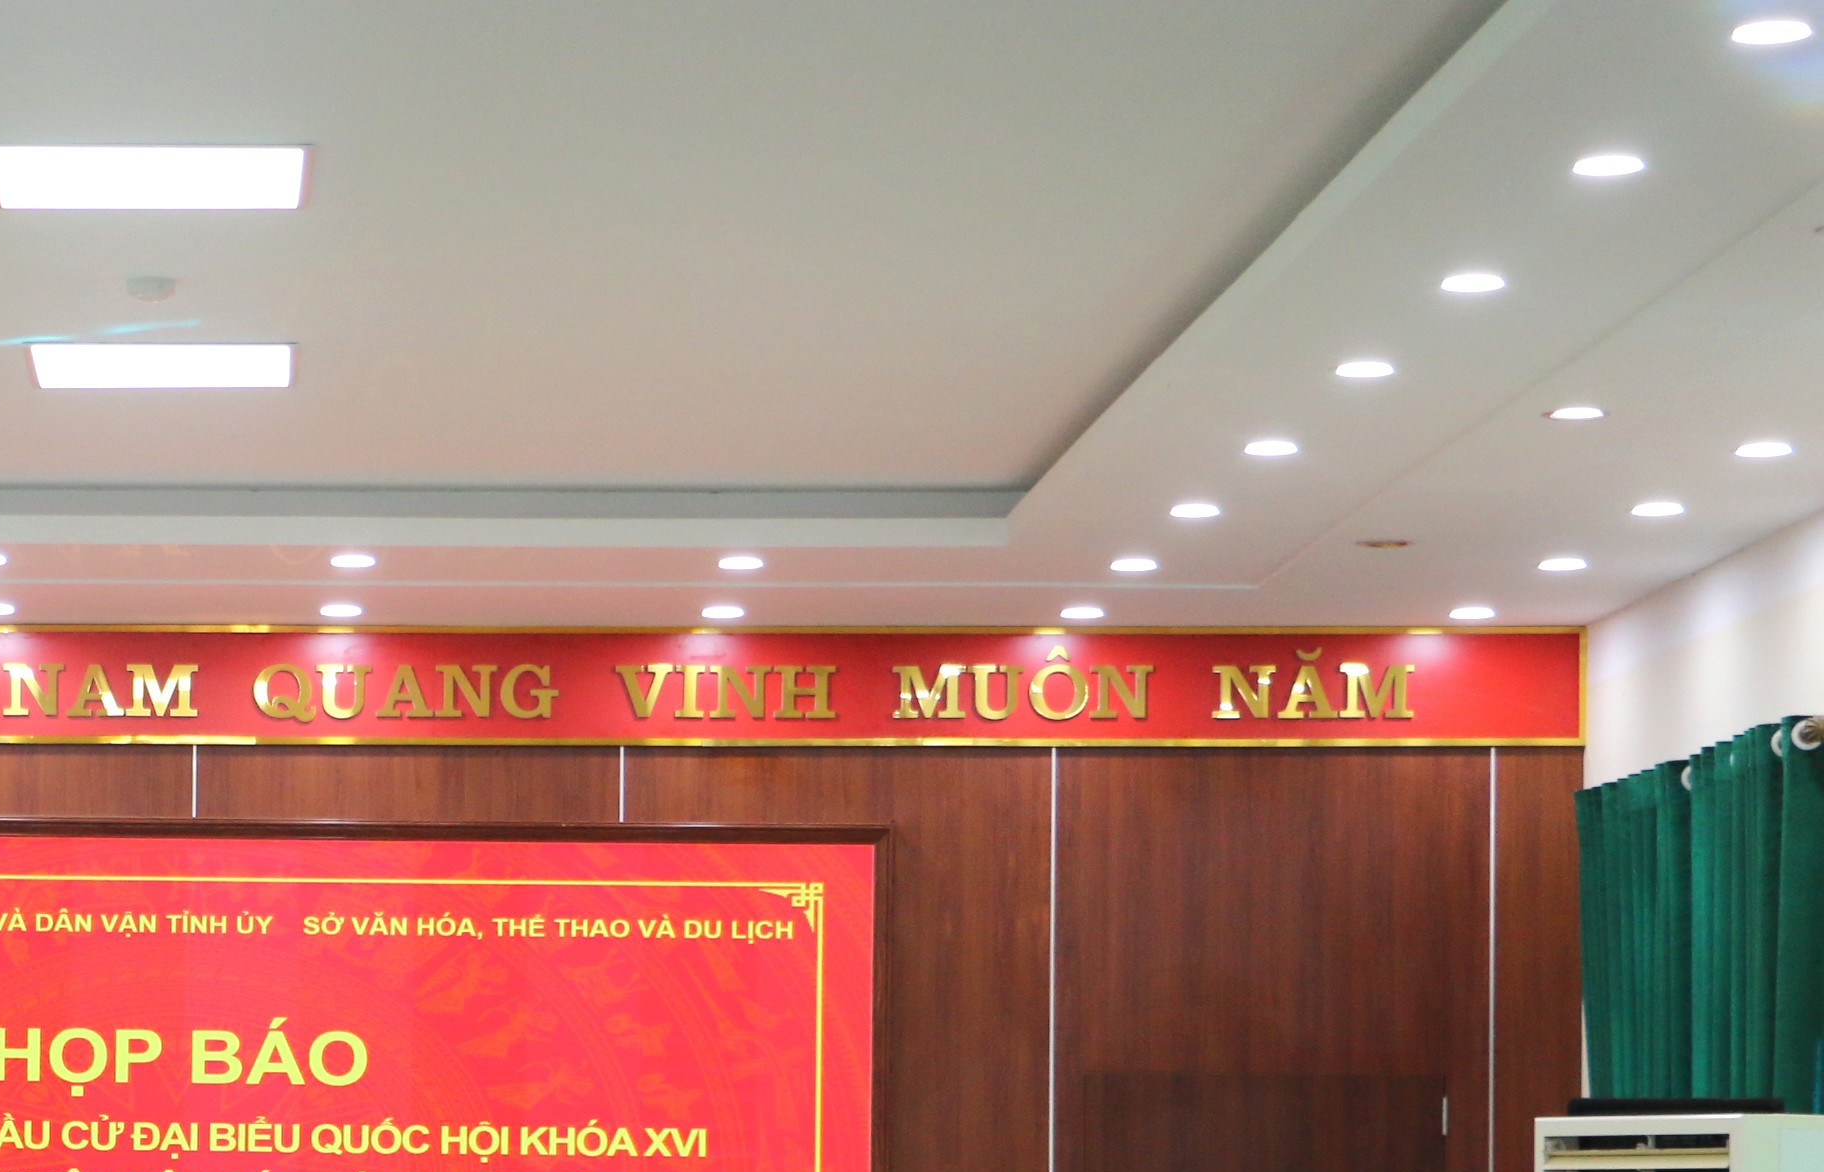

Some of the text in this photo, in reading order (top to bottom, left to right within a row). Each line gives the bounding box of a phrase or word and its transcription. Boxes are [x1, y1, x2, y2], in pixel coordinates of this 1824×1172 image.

[1, 662, 198, 717] NAM
[253, 663, 559, 722] QUANG
[615, 664, 837, 719] VINH
[891, 646, 1154, 720] MUÔN
[1211, 646, 1415, 719] NĂM
[35, 907, 93, 933] DÂN
[100, 911, 157, 938] VẬN
[165, 909, 228, 934] TỈNH
[236, 910, 274, 935] ỦY
[303, 911, 346, 936] SỞ
[350, 911, 408, 936] VĂN
[416, 911, 483, 941] HÓA,
[553, 918, 631, 938] THAO
[637, 913, 677, 939] VÀ
[683, 919, 723, 939] DU
[731, 920, 794, 945] LỊCH
[191, 1016, 369, 1087] BÁO
[61, 1113, 125, 1151] CỬ
[130, 1121, 199, 1160] ĐẠI
[209, 1115, 301, 1154] BIỂU
[310, 1117, 430, 1156] QUỐC
[440, 1120, 510, 1164] HỘI
[519, 1119, 639, 1157] KHÓA
[643, 1127, 707, 1158] XVI
